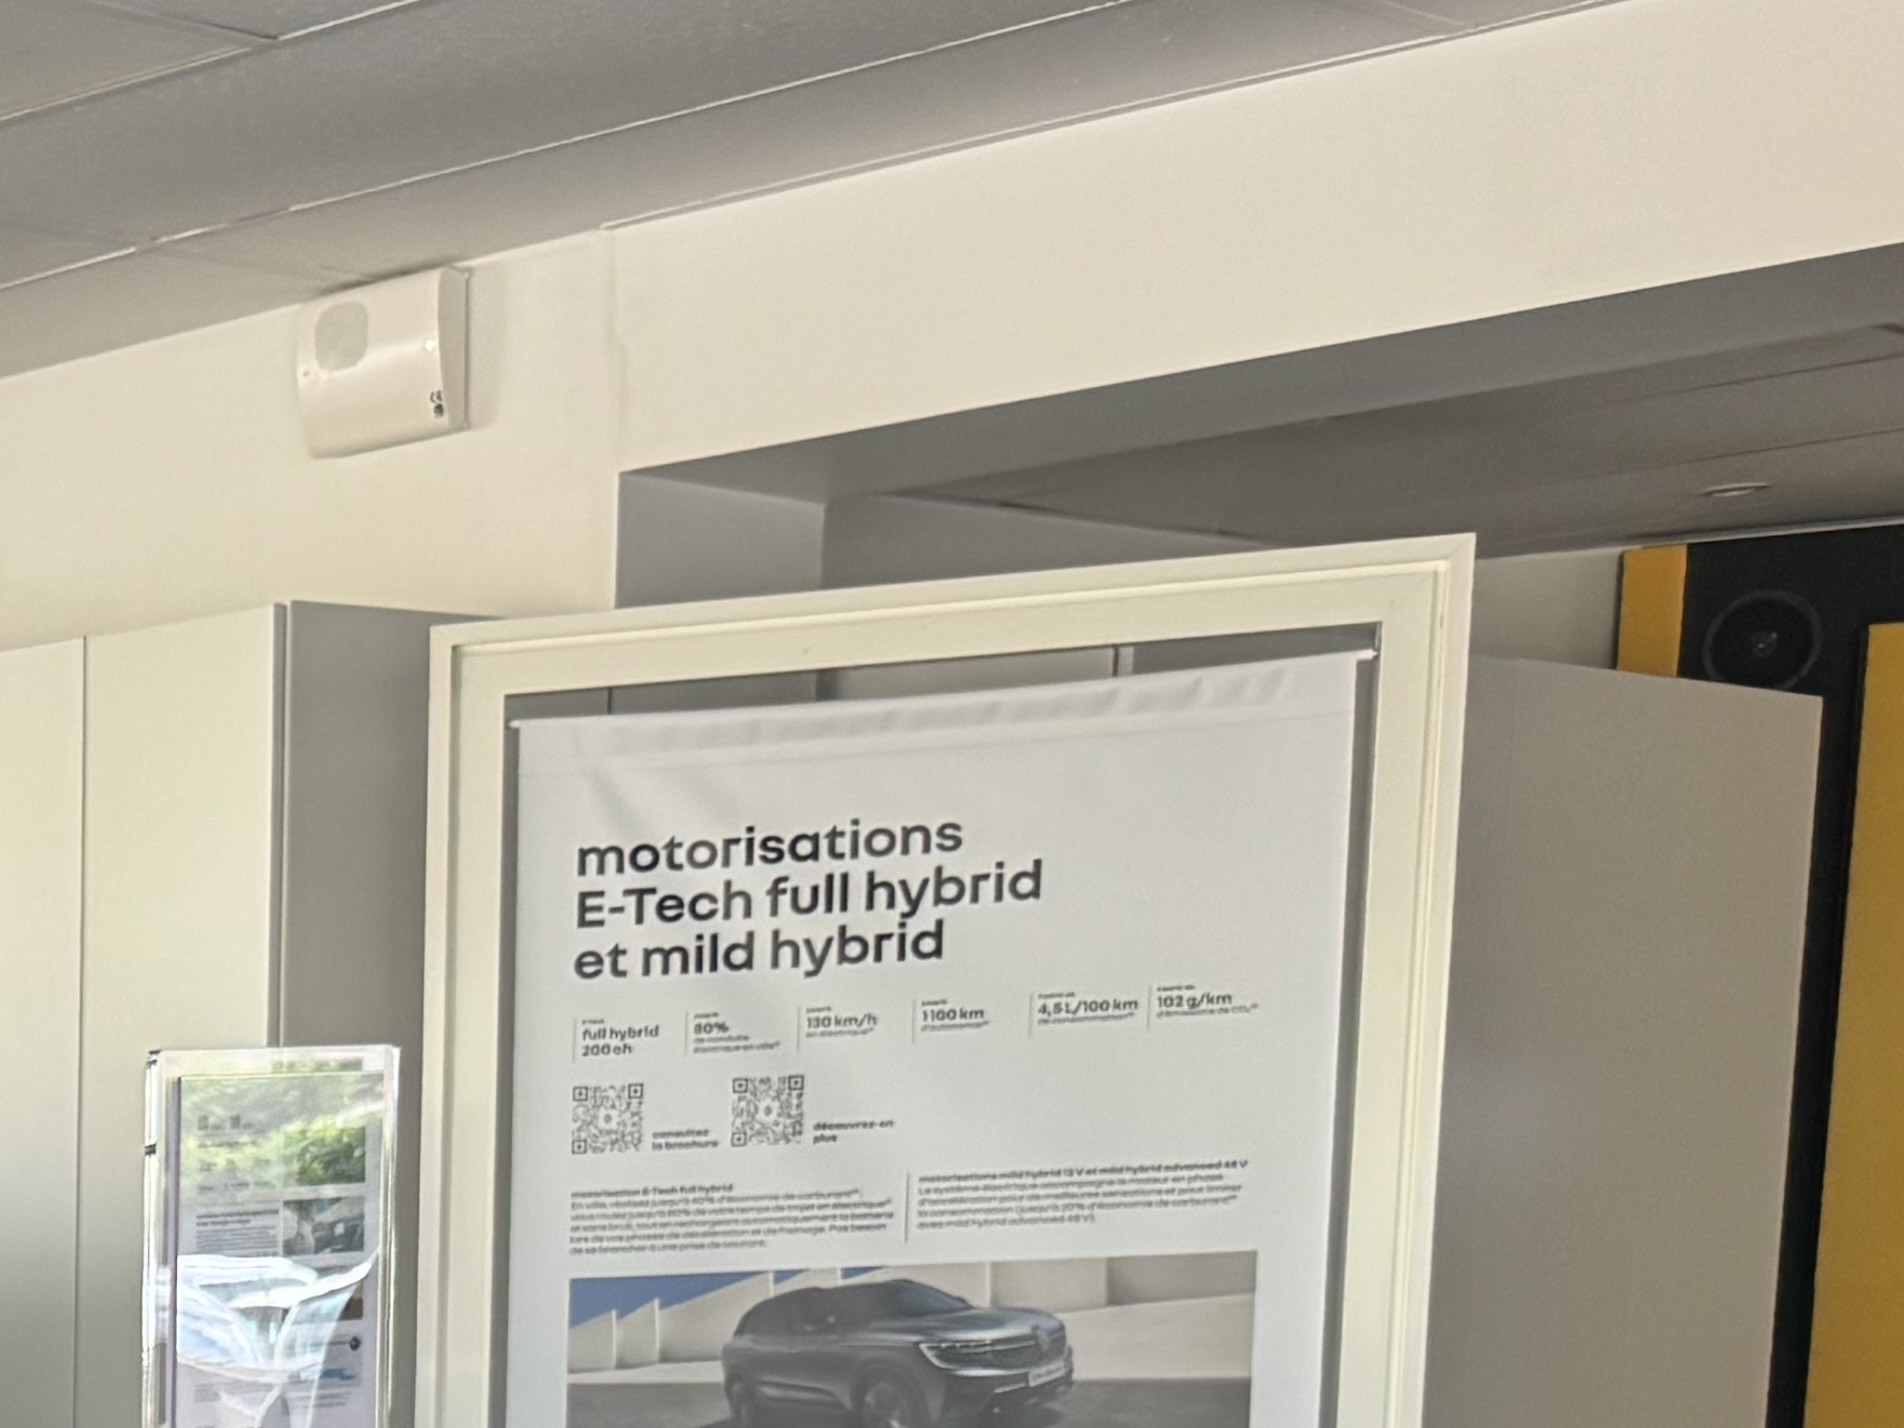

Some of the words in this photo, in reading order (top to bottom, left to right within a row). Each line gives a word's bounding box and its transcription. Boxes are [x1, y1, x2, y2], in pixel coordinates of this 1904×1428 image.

[576, 818, 964, 877] motorisations
[577, 879, 753, 929] E-Tech
[766, 871, 849, 918] full
[865, 858, 1043, 920] hybrid
[574, 942, 628, 980] et
[641, 930, 756, 977] mild
[770, 918, 944, 979] hybrid
[1112, 997, 1139, 1012] km
[1186, 992, 1233, 1011] g/km
[833, 1012, 879, 1028] km/h
[959, 1006, 985, 1020] km
